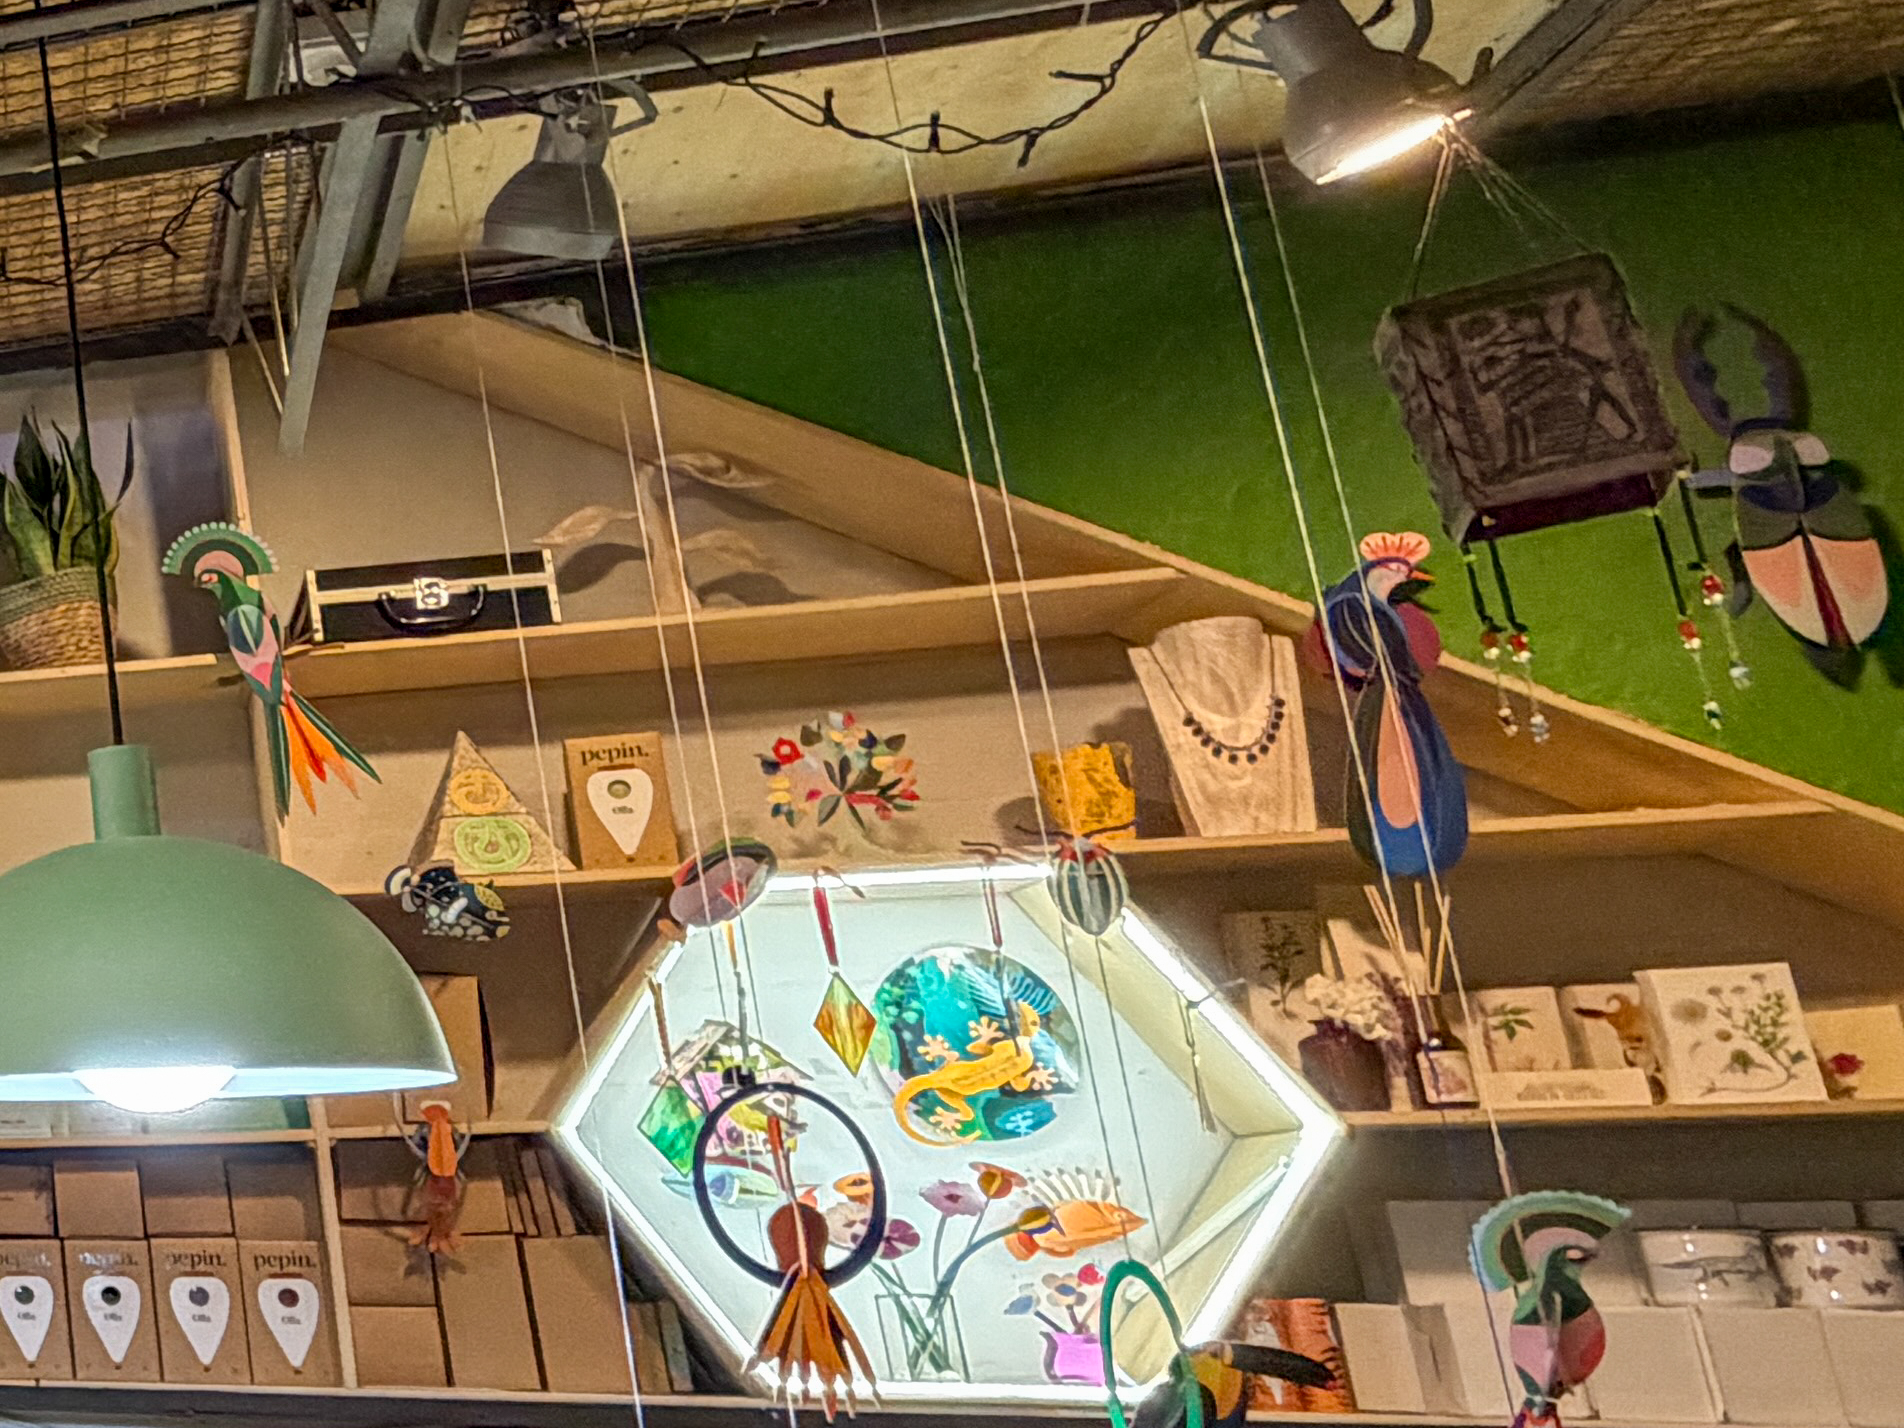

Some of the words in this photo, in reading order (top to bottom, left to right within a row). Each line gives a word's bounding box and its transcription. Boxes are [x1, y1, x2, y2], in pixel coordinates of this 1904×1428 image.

[580, 742, 649, 766] pepin.
[165, 1249, 227, 1270] pepin.
[253, 1253, 317, 1271] pepin.
